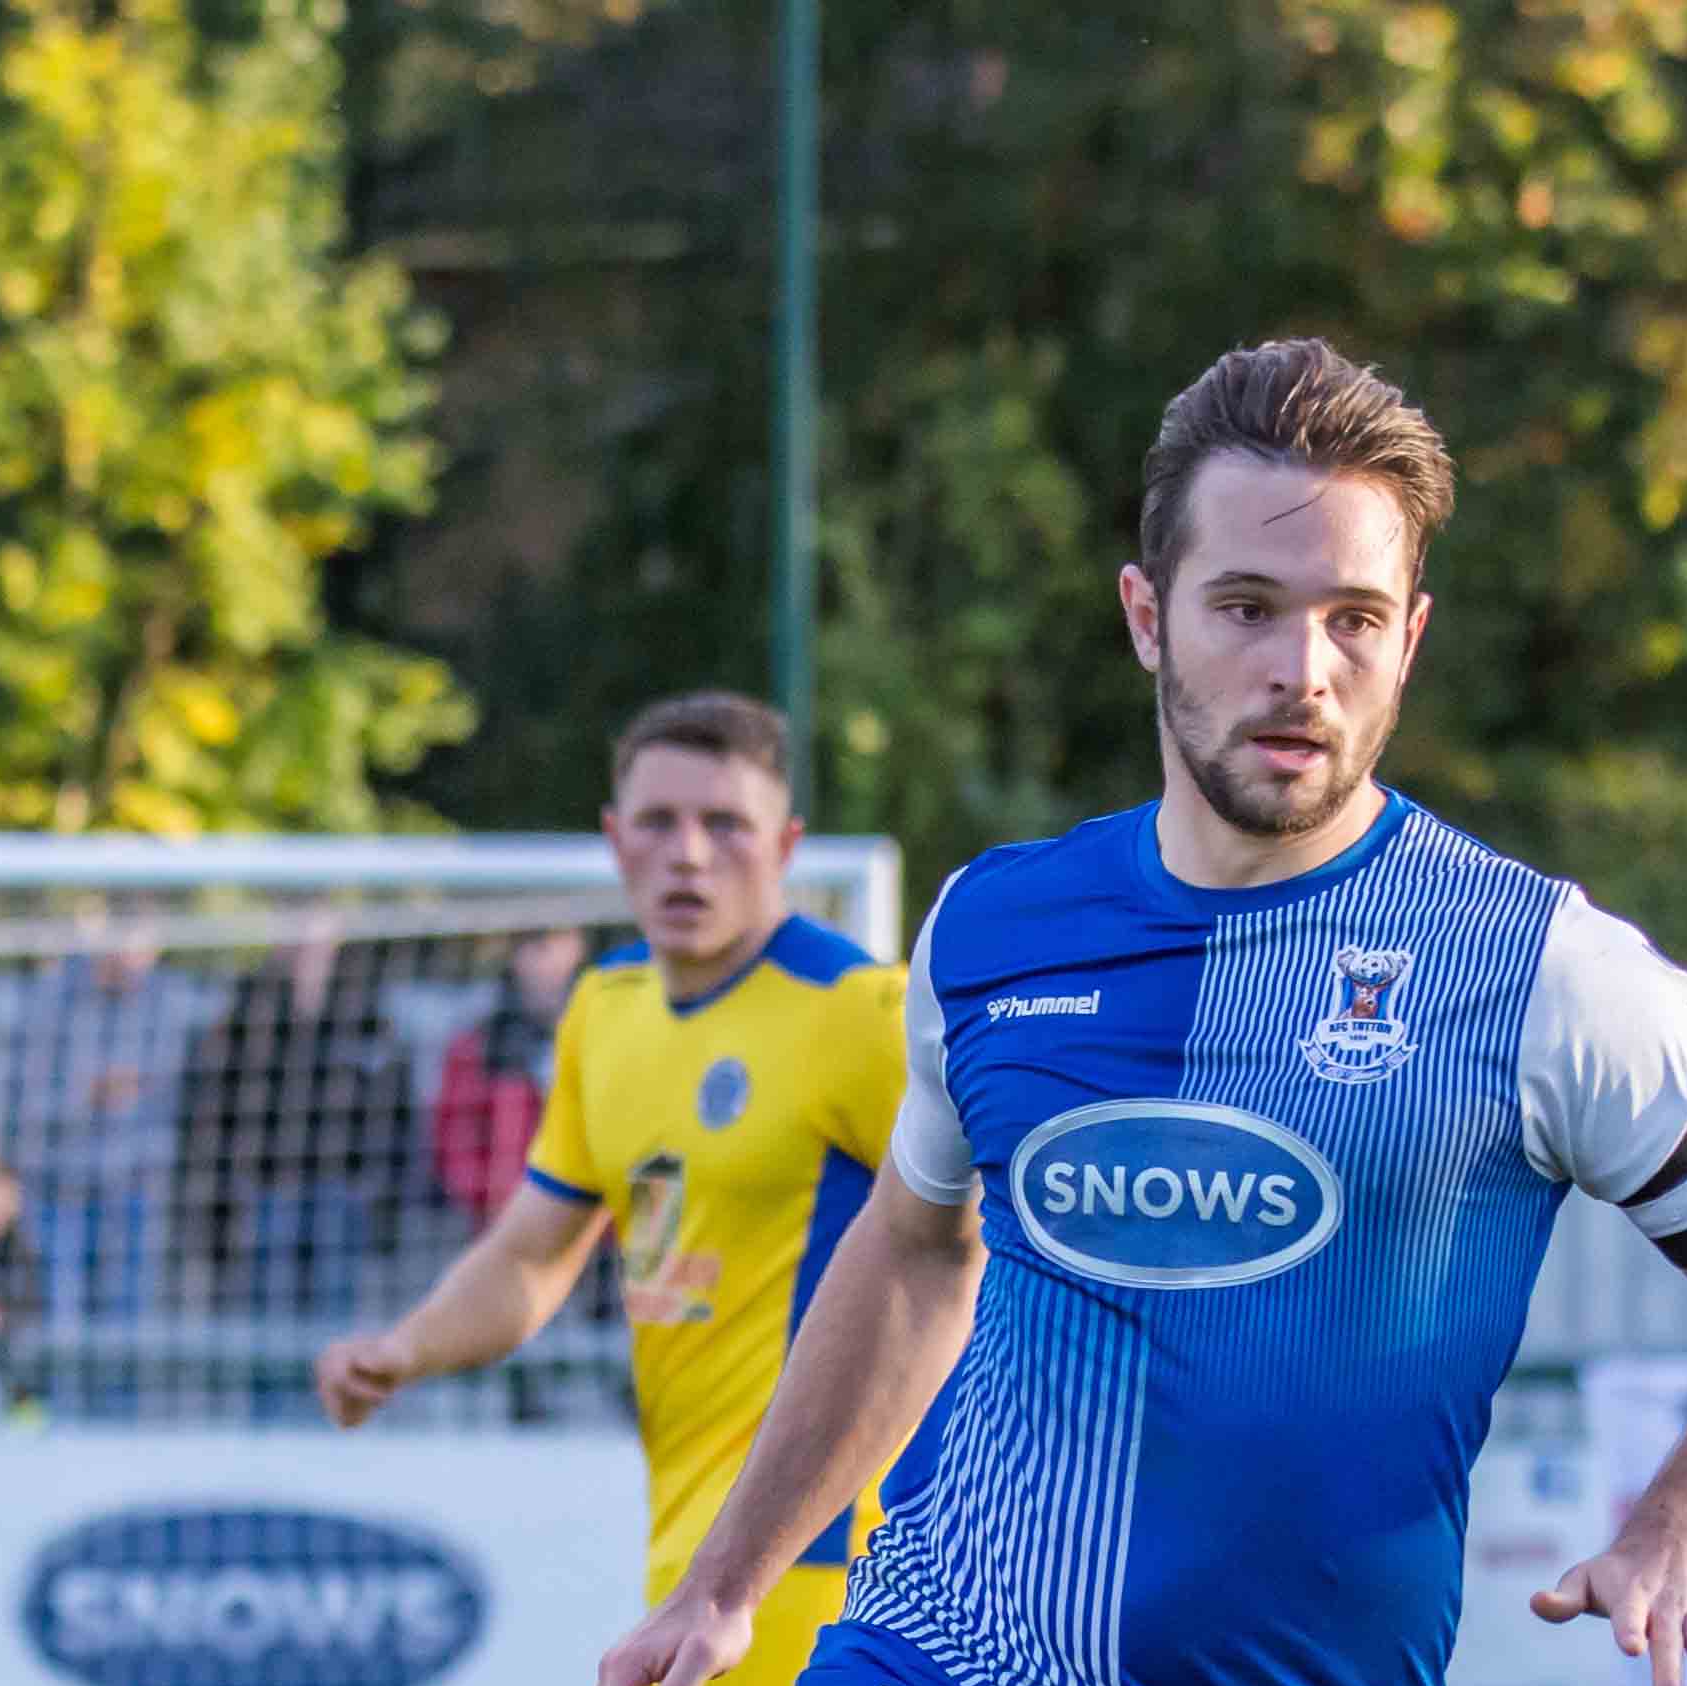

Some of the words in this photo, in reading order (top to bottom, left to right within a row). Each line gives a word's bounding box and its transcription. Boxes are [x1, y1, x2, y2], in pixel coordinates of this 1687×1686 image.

[1006, 989, 1101, 1018] hummel
[1043, 1161, 1298, 1227] SNOWS
[49, 1562, 456, 1664] SNOWS
